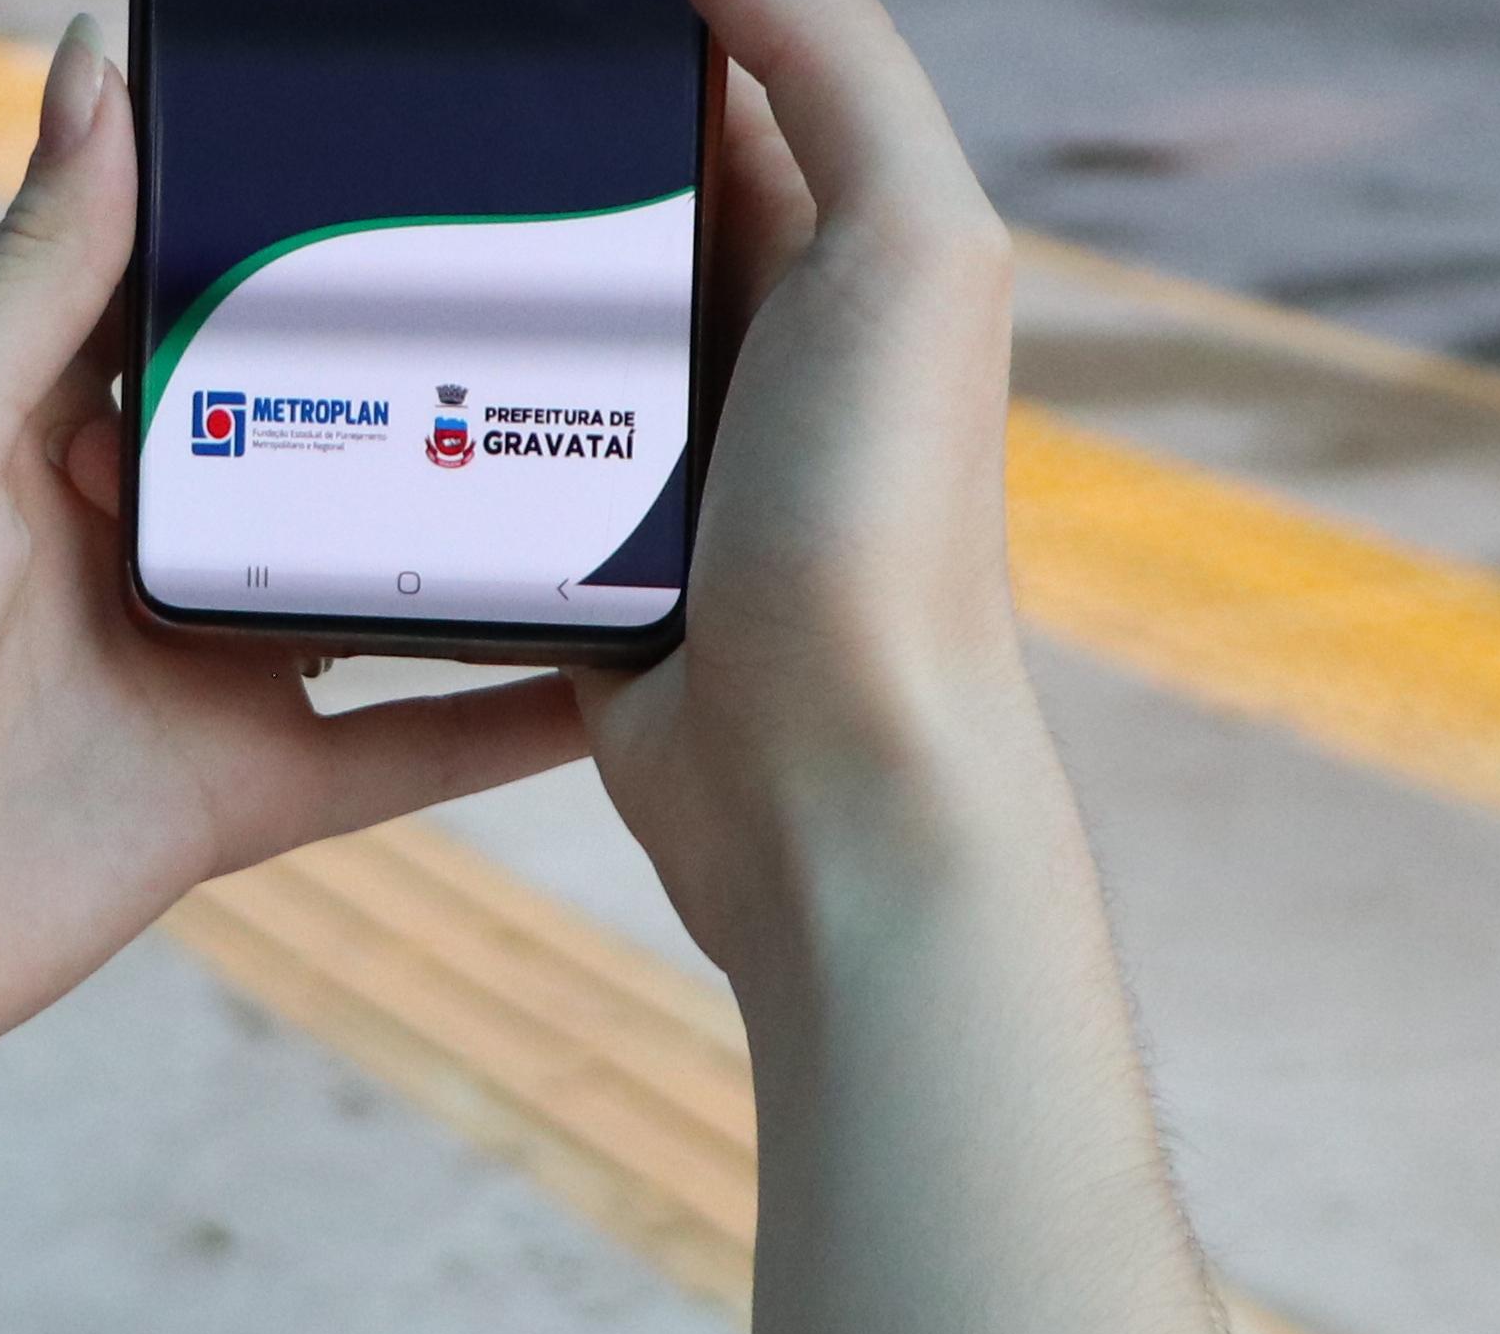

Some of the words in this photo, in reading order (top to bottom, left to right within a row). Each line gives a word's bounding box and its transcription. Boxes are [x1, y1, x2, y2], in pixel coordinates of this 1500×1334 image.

[252, 397, 389, 425] METROPLAN
[484, 407, 604, 427] PREFEITURA
[609, 411, 635, 427] DE
[483, 428, 635, 459] GRAVATAÍ
